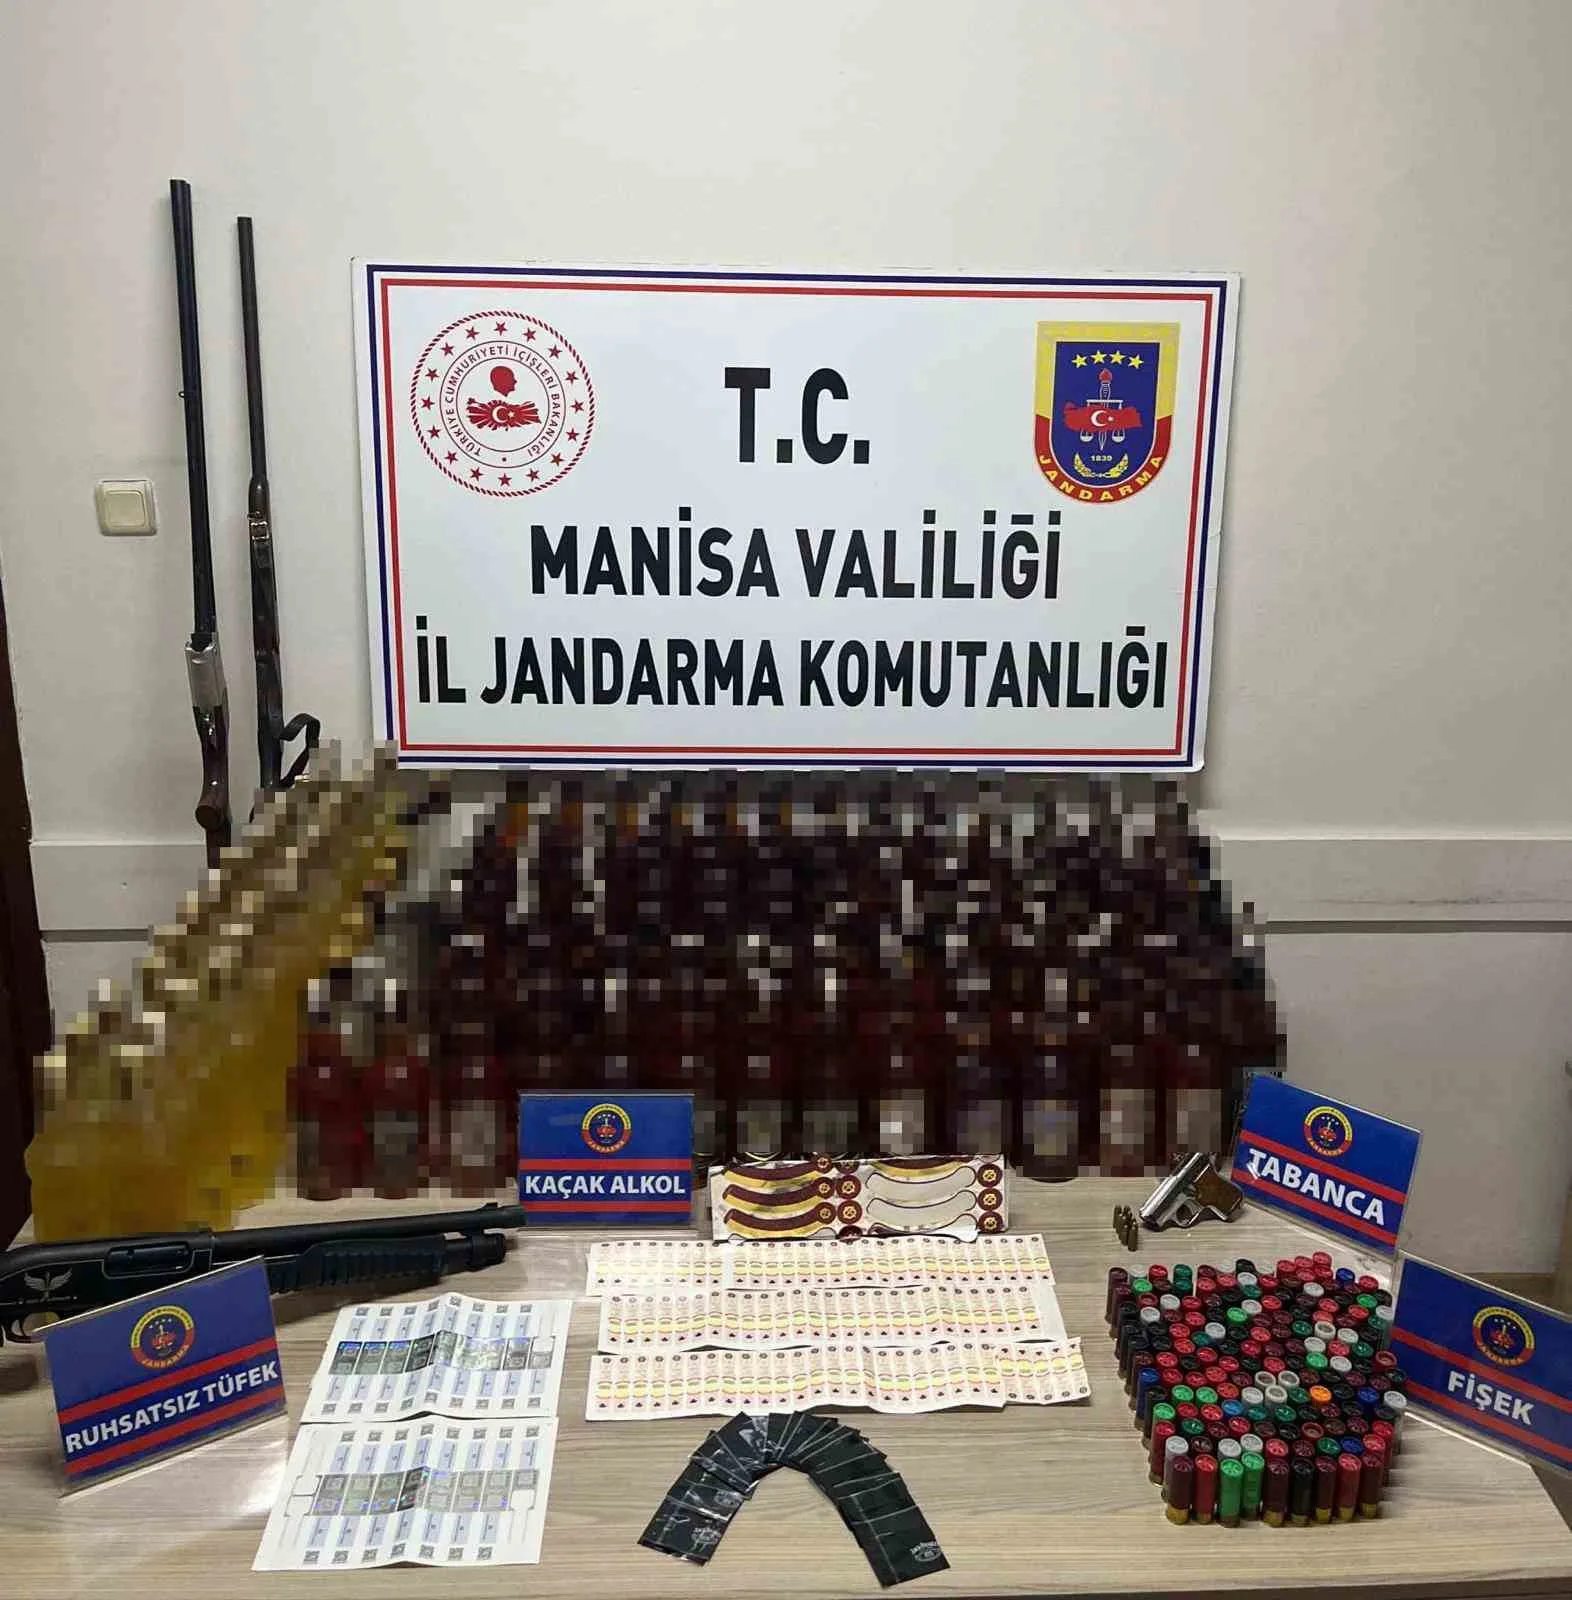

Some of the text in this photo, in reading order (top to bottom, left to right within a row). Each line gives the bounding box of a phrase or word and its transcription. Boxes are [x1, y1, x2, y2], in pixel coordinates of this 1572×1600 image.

[446, 345, 510, 404] CUMHURİYETİ
[513, 346, 560, 393] İÇİŞLERİ
[528, 393, 562, 457] BAKANLIĞI
[725, 366, 870, 465] T.C.
[1039, 453, 1164, 501] JANDARMA
[530, 507, 1061, 599] MANİSA VALİLİĞİ
[417, 616, 1168, 708] İL JANDARMA KOMUTANLIĞI
[525, 1175, 685, 1199] KAÇAK ALKOL
[1248, 1148, 1386, 1226] TABANCA
[65, 1360, 279, 1453] RUHSATSIZ TÜFEK
[1447, 1370, 1535, 1425] FİŞEK
